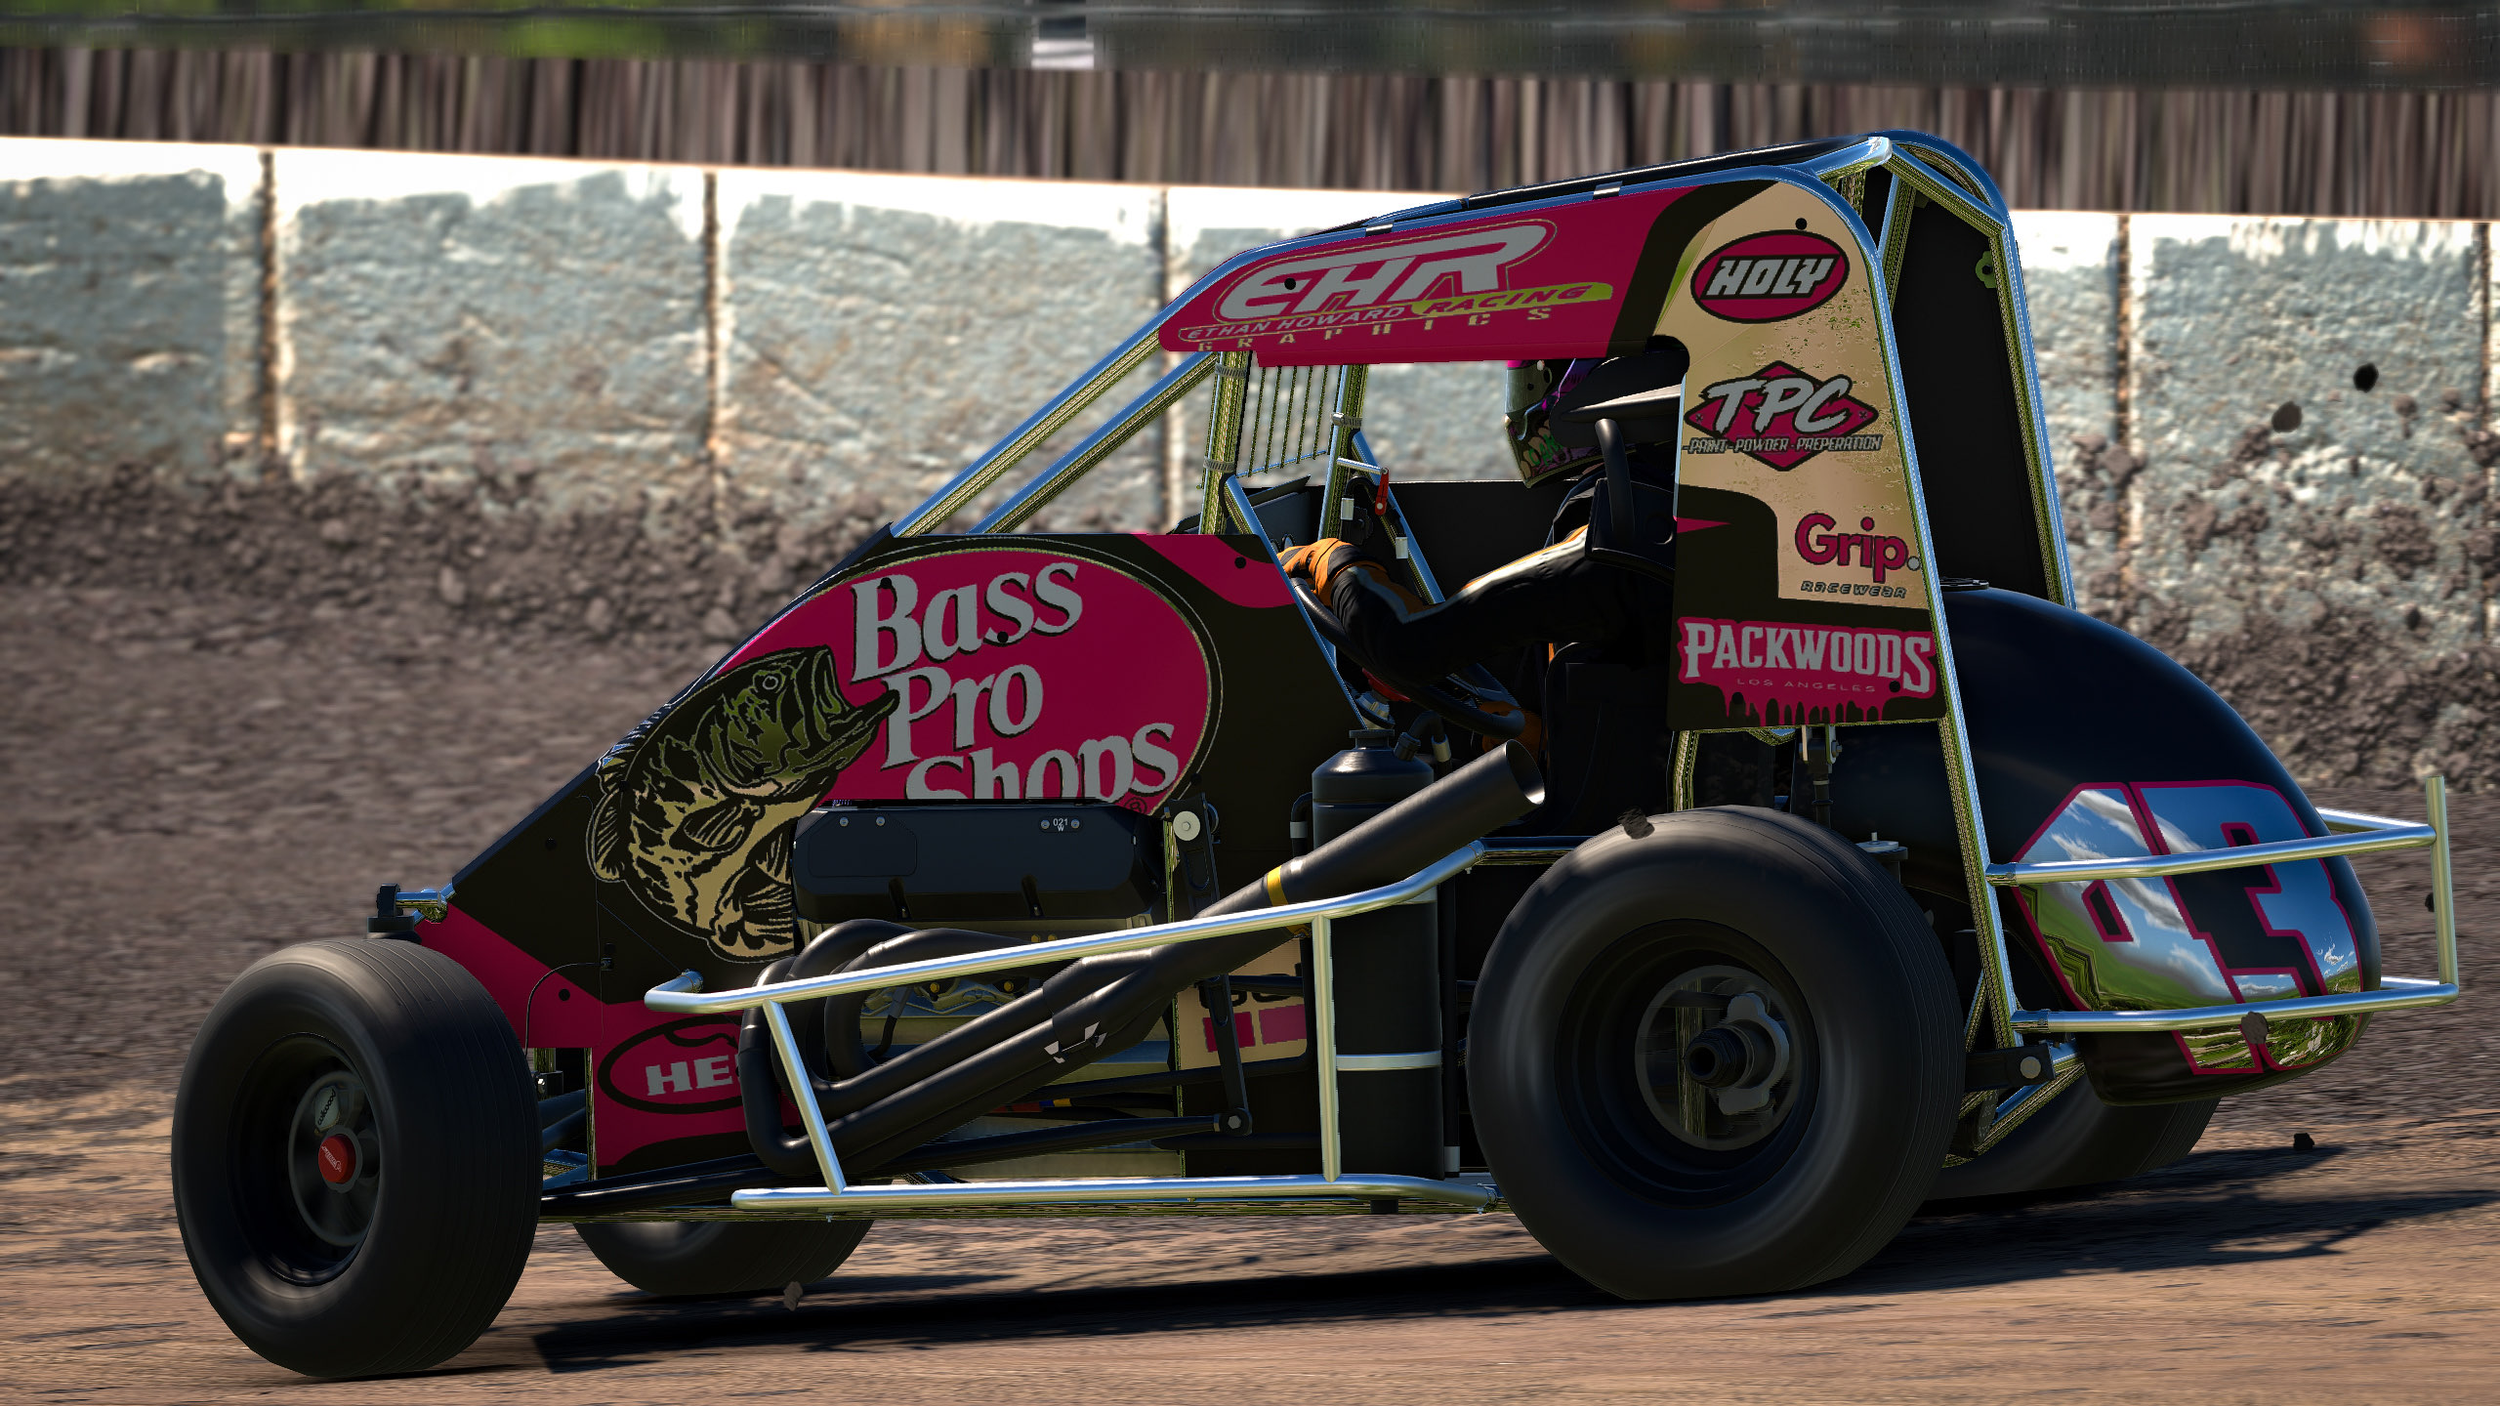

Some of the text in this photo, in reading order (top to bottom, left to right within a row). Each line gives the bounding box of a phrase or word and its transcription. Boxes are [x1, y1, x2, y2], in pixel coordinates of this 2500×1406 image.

[1218, 224, 1546, 320] EHR
[1704, 257, 1835, 297] HOLY
[1187, 284, 1594, 340] ETHAN HOWARD RACING
[1197, 306, 1553, 352] GRAPHICS
[1706, 376, 1852, 435] TPC
[850, 562, 1084, 684] Bass
[1683, 622, 1931, 694] PACKWOODS
[1736, 678, 1876, 693] LOS ANGELES
[880, 663, 1044, 770] Pro
[644, 1054, 740, 1097] HE
